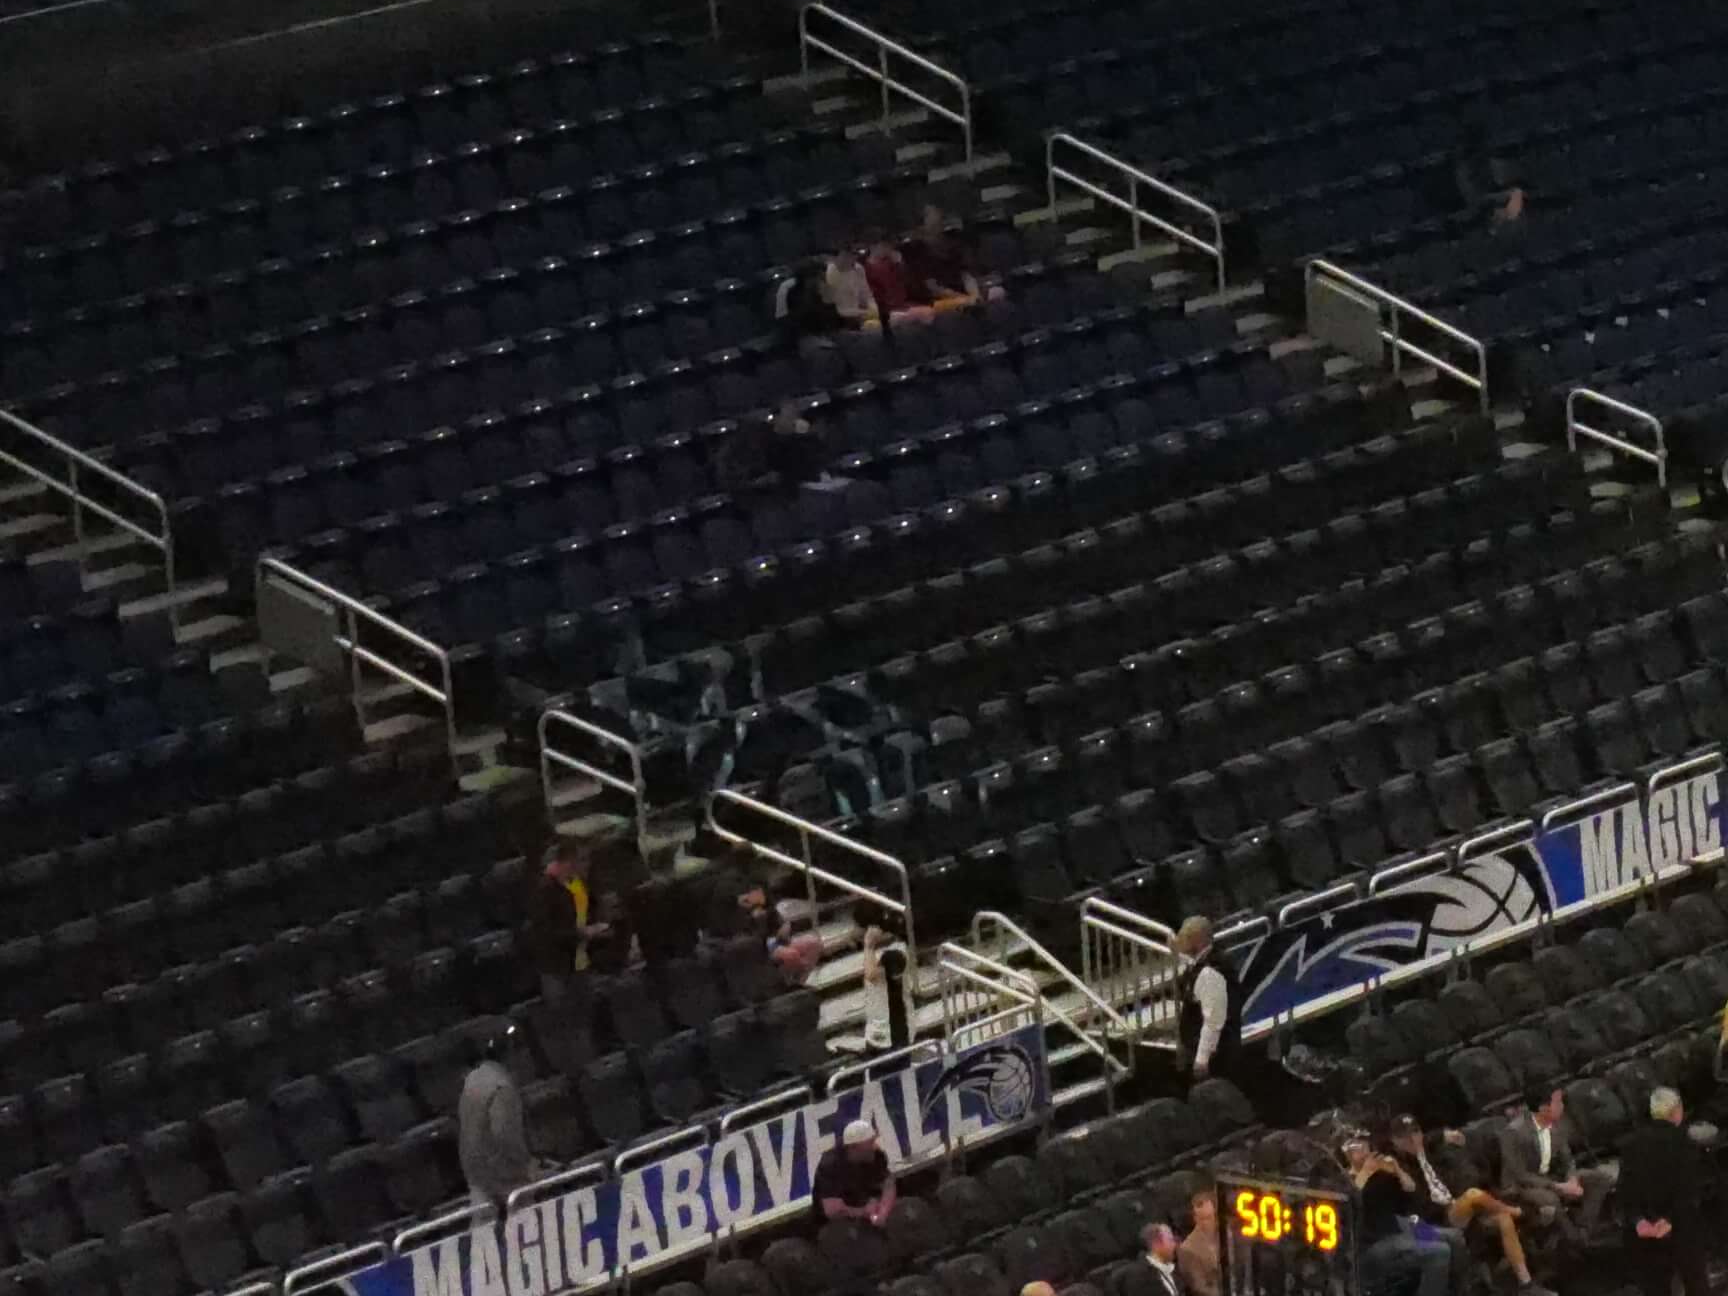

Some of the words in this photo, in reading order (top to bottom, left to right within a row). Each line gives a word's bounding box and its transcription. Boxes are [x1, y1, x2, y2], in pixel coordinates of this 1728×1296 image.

[1579, 775, 1723, 897] MAGIC
[860, 1064, 982, 1164] ALL
[1235, 1191, 1339, 1251] 50:19
